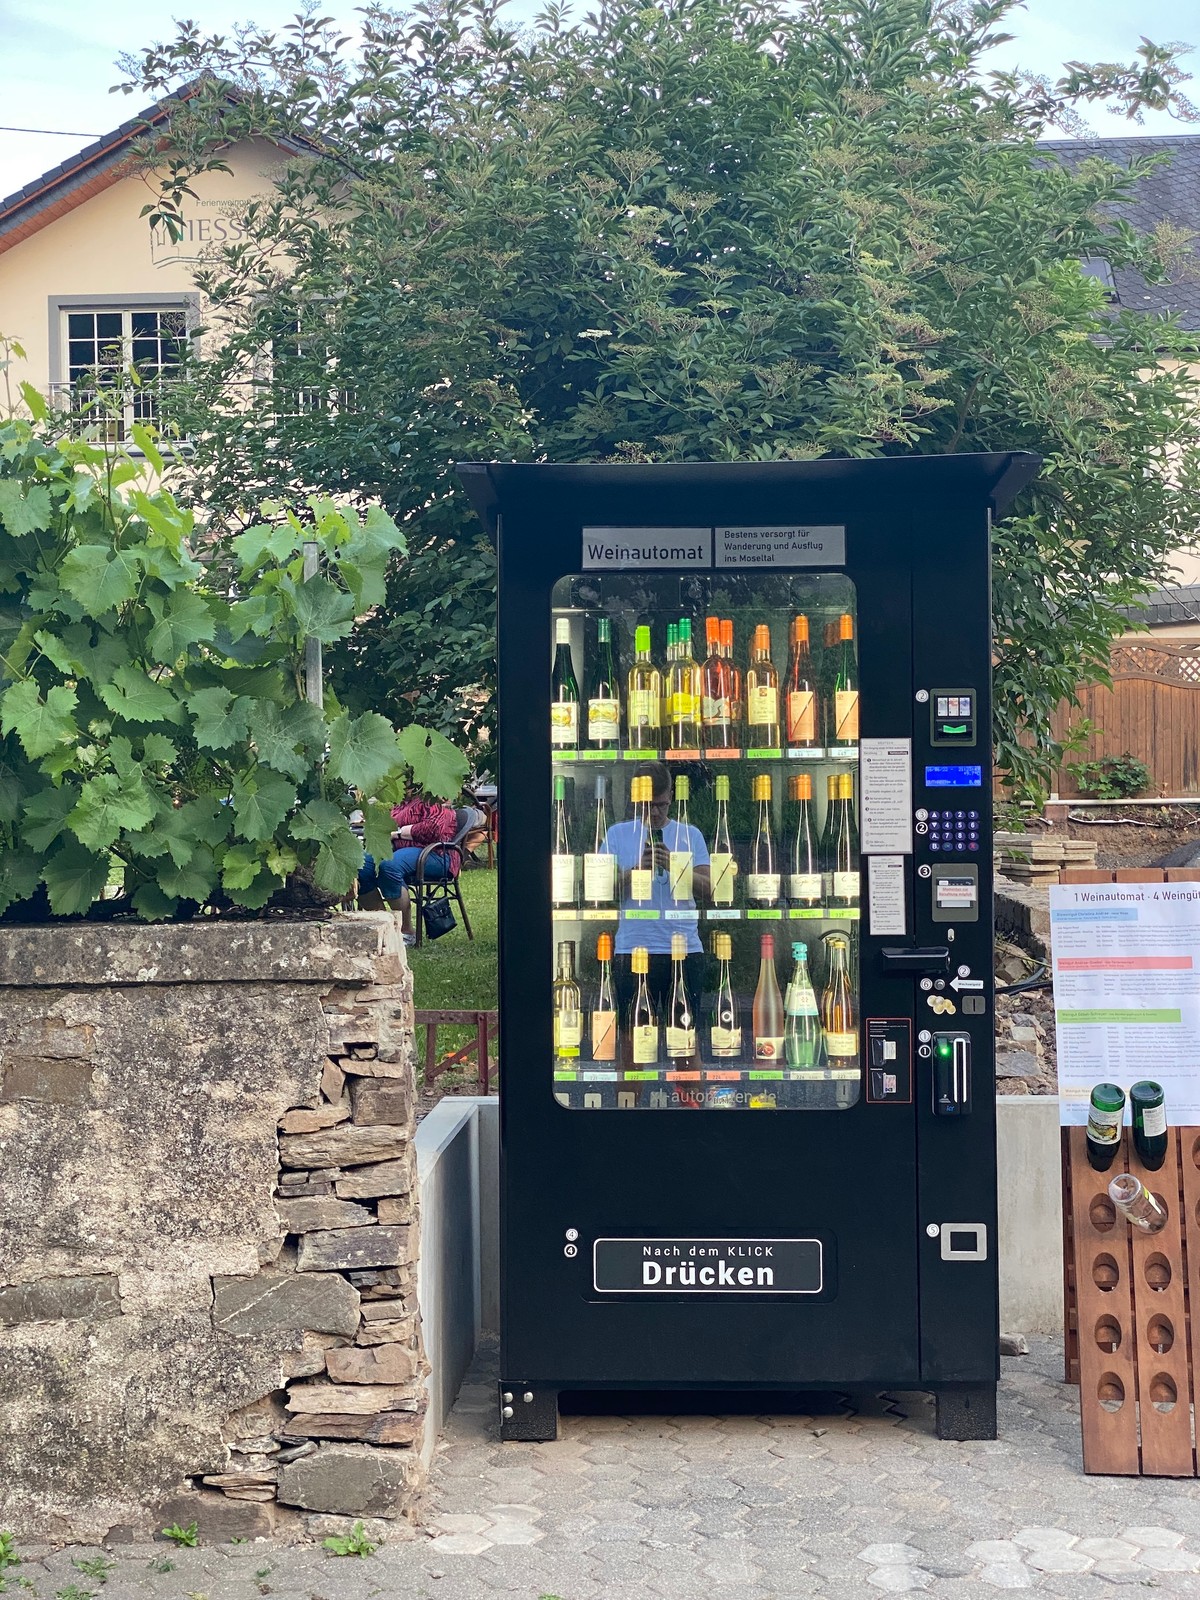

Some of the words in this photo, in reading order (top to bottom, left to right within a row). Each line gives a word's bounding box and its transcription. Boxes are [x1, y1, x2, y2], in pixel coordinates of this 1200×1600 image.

[724, 530, 758, 539] Bestens
[760, 530, 796, 540] versorgt
[798, 529, 810, 538] für
[588, 544, 703, 560] Weinautomat
[724, 542, 772, 552] Wanderung
[773, 541, 789, 550] und
[791, 541, 823, 551] Ausflug
[724, 554, 737, 562] ins
[739, 553, 775, 562] Moseltal
[1074, 892, 1078, 902] 1
[1081, 892, 1144, 902] Weinautomat
[1153, 891, 1159, 900] 4
[643, 1246, 680, 1256] Nach
[690, 1246, 719, 1256] dem
[728, 1246, 774, 1256] KLICK
[642, 1260, 774, 1286] Drücken
